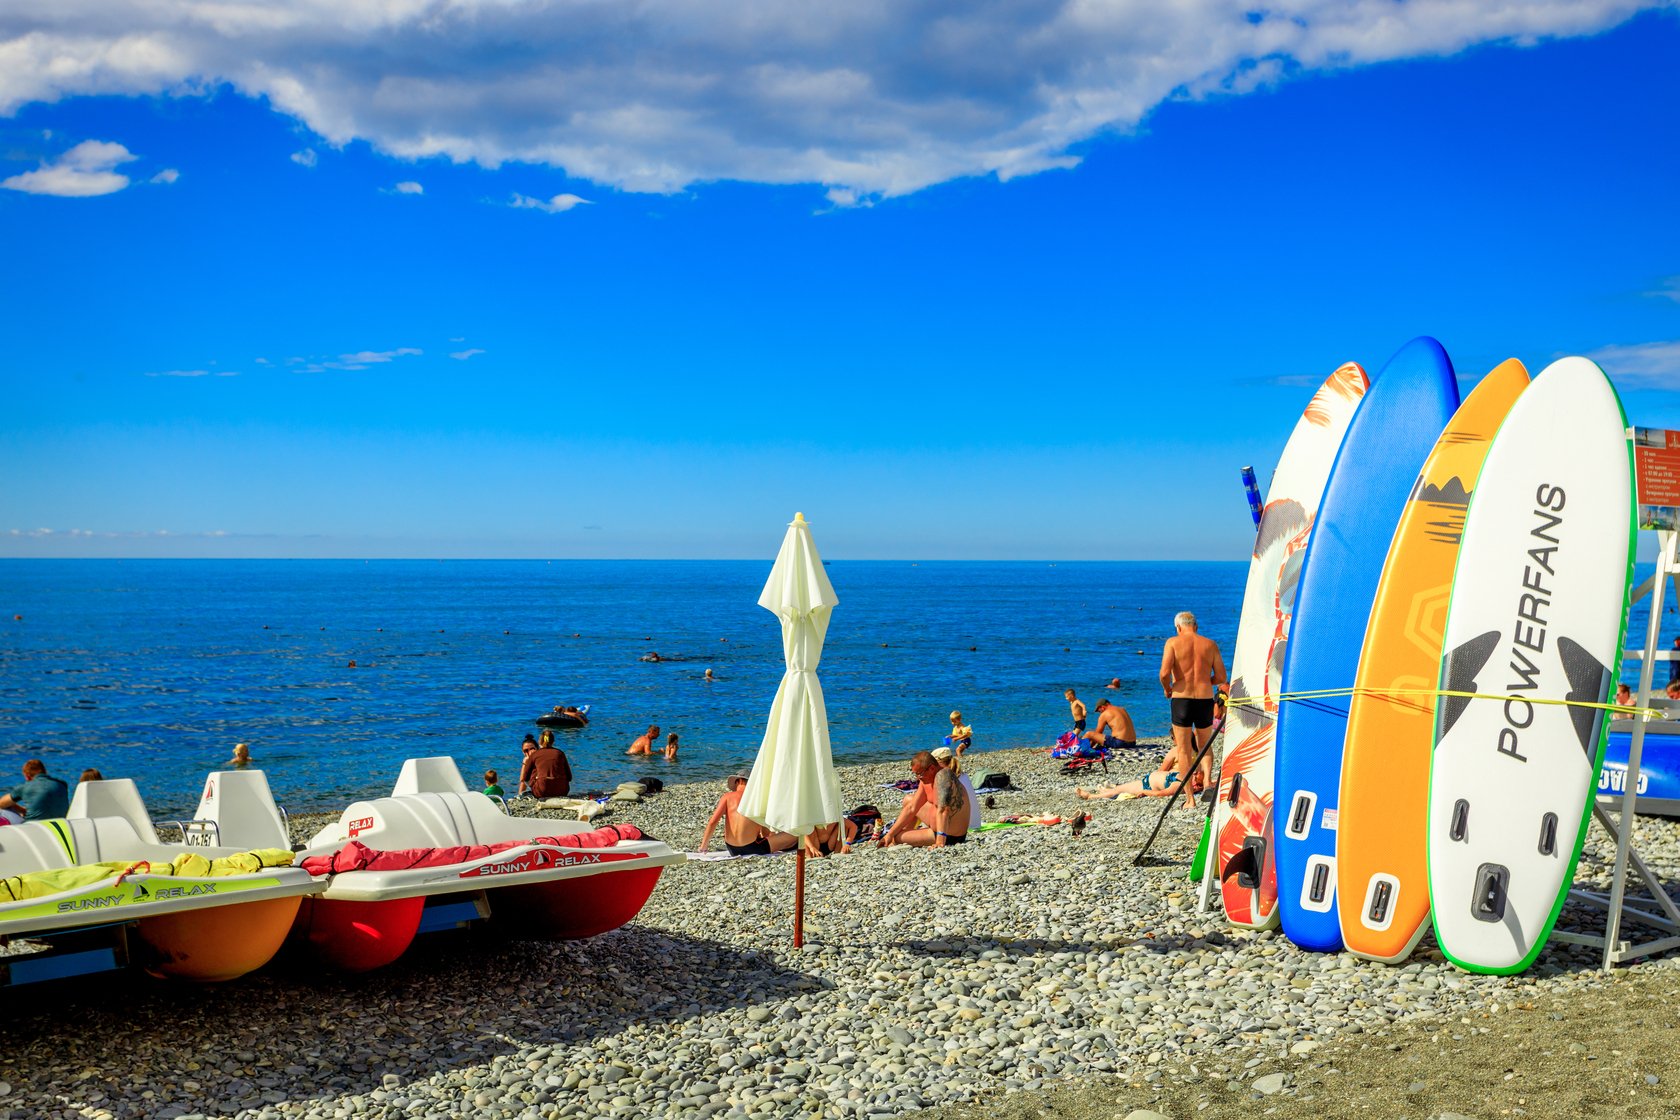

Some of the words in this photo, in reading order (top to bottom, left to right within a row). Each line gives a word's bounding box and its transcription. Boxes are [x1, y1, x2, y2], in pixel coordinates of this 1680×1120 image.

[1497, 484, 1566, 763] POWERFANS
[350, 818, 372, 830] RELAX
[480, 862, 530, 876] SUNNY
[555, 854, 600, 867] RELAX
[57, 894, 124, 912] SUNNY
[155, 883, 216, 900] RELAX
